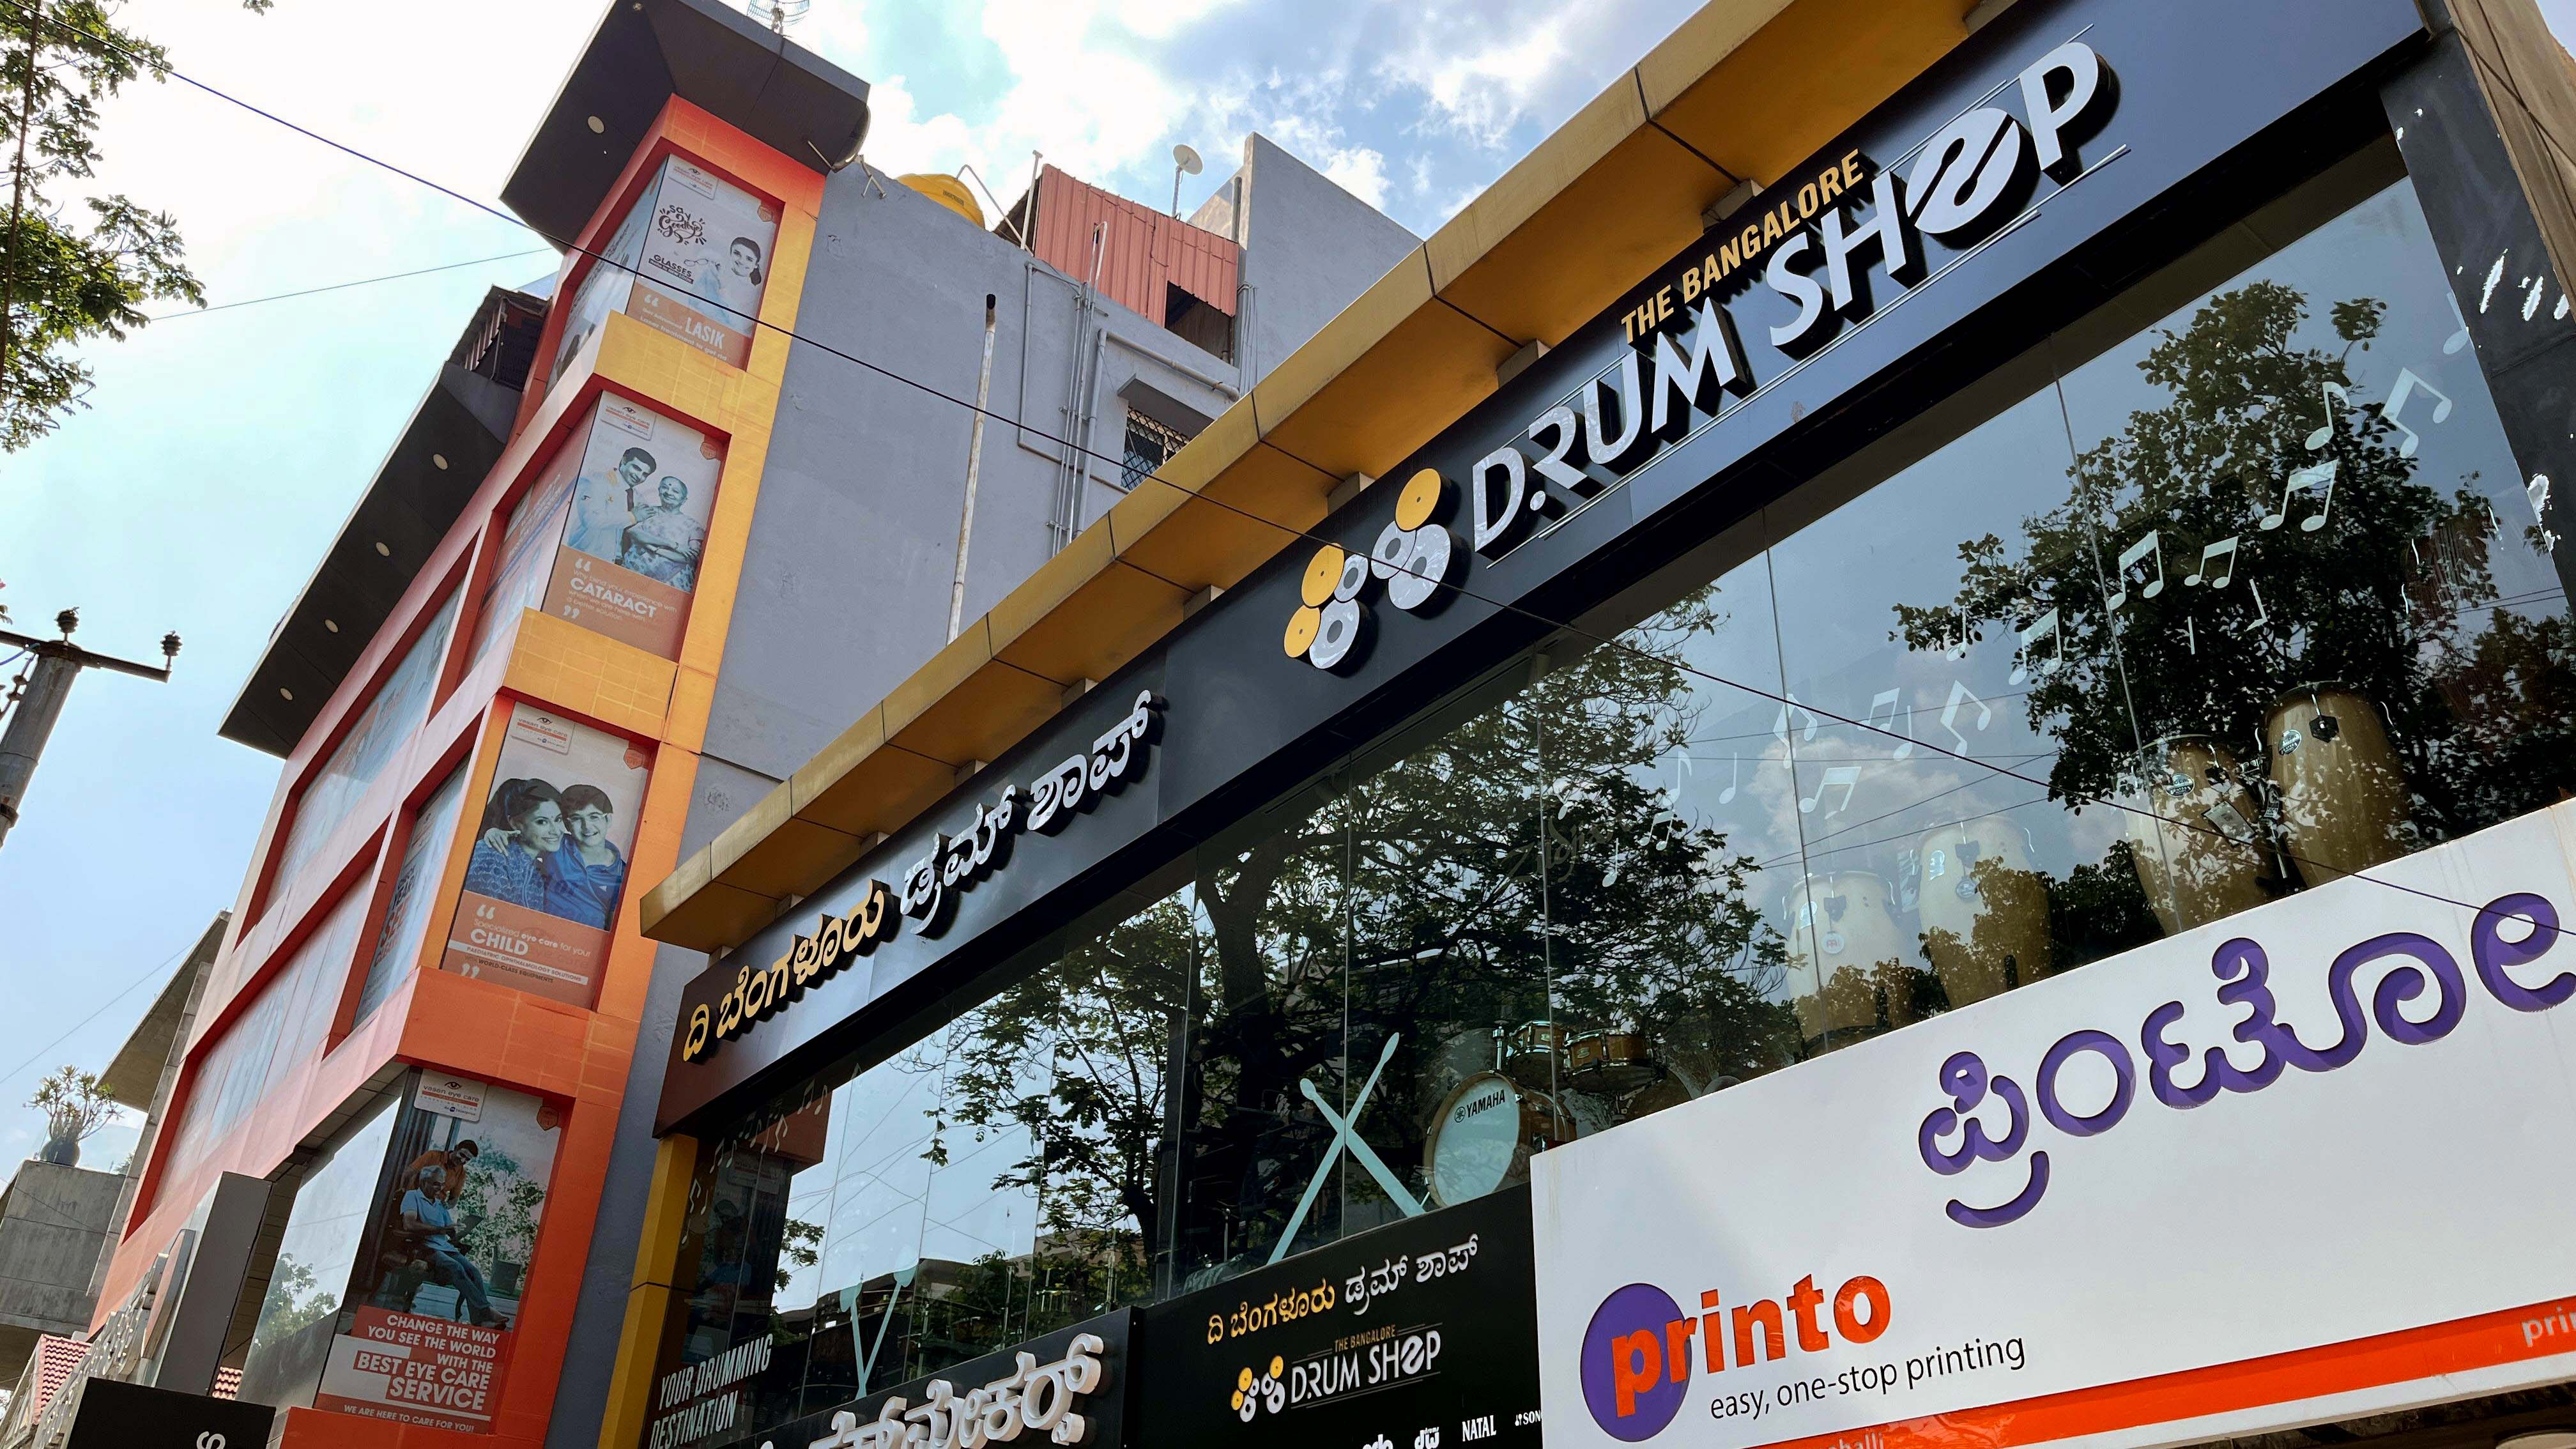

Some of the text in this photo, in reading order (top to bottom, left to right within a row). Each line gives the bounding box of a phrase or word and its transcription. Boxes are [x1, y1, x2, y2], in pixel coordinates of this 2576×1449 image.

[1621, 148, 1864, 344] THE BANGALORE
[654, 254, 692, 277] GLASSES
[1472, 42, 2099, 553] DRUM SHOP
[685, 316, 725, 350] LASIK
[570, 577, 657, 618] CATARACT
[716, 879, 886, 1040] ಬೆಂಗಳೂರು
[1028, 689, 1152, 831] ಶಾಪ್
[470, 928, 529, 956] CHILD
[521, 933, 537, 942] eye
[539, 938, 558, 948] care
[560, 942, 571, 951] for
[572, 947, 591, 958] your
[479, 959, 518, 974] WORLD-CLASS
[519, 970, 554, 984] EQUIPMENTS
[551, 968, 582, 983] SOLUTIONS
[423, 1085, 446, 1094] vasan
[463, 1094, 479, 1102] care
[1466, 1089, 1505, 1118] YAMAHA
[1230, 1278, 1335, 1338] ಬೆಂಗಳೂರು
[1415, 1234, 1478, 1283] ಶಾಪ್
[368, 1326, 496, 1358] YOU SEE THE WORLD
[387, 1314, 500, 1344] CHANGE THE WAY
[1334, 1324, 1396, 1353] THE BANGALORE
[1611, 1273, 1891, 1418] printo
[357, 1353, 491, 1390] BEST EYE CARE
[437, 1353, 493, 1373] WITH THE
[659, 1333, 773, 1411] YOUR DRUMMING
[1291, 1330, 1441, 1404] DRUM SHOP
[1711, 1333, 2027, 1420] easy, one-stop printing
[390, 1377, 486, 1411] SERVICE
[344, 1404, 474, 1432] WE ARE HERE TO CARE FOR YOU!
[649, 1390, 739, 1449] DESTINATION
[1462, 1415, 1497, 1442] NATAL
[1523, 1409, 1543, 1425] SON
